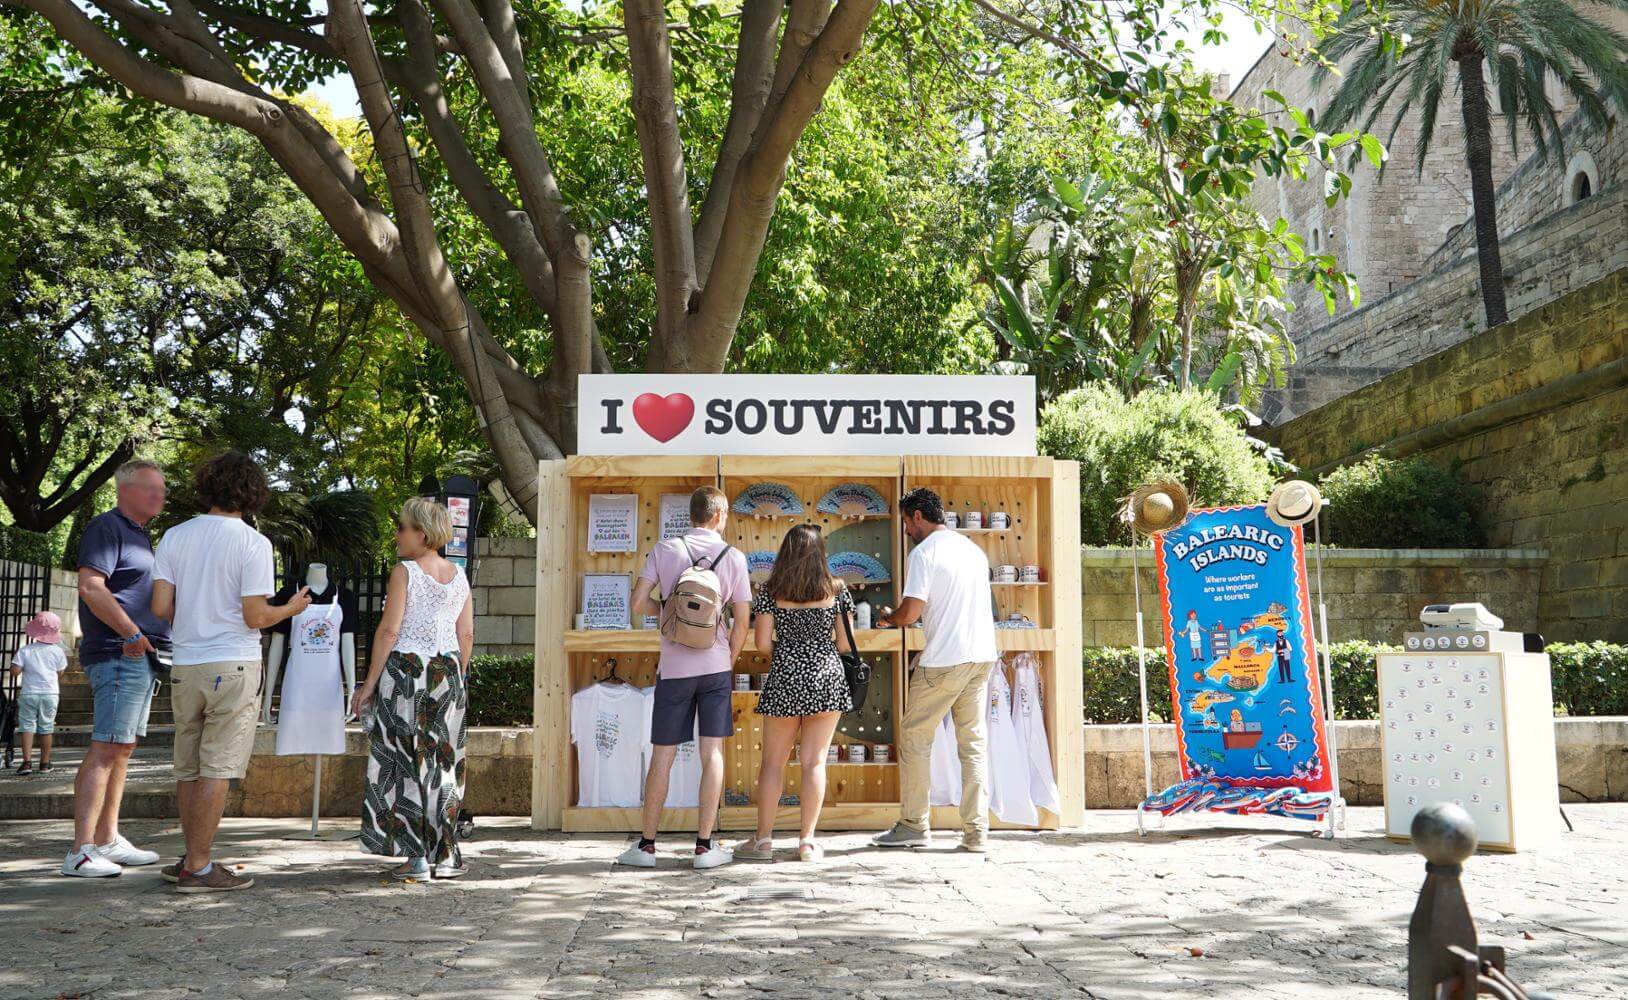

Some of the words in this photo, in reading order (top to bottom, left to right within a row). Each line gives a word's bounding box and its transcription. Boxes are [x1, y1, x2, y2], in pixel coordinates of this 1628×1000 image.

[600, 399, 623, 435] I
[704, 398, 1015, 435] SOUVENIRS
[1172, 524, 1284, 560] BALEARIC
[1189, 545, 1268, 572] ISLANDS
[1227, 573, 1255, 582] workers
[1224, 593, 1250, 601] tourists
[1226, 583, 1259, 593] important
